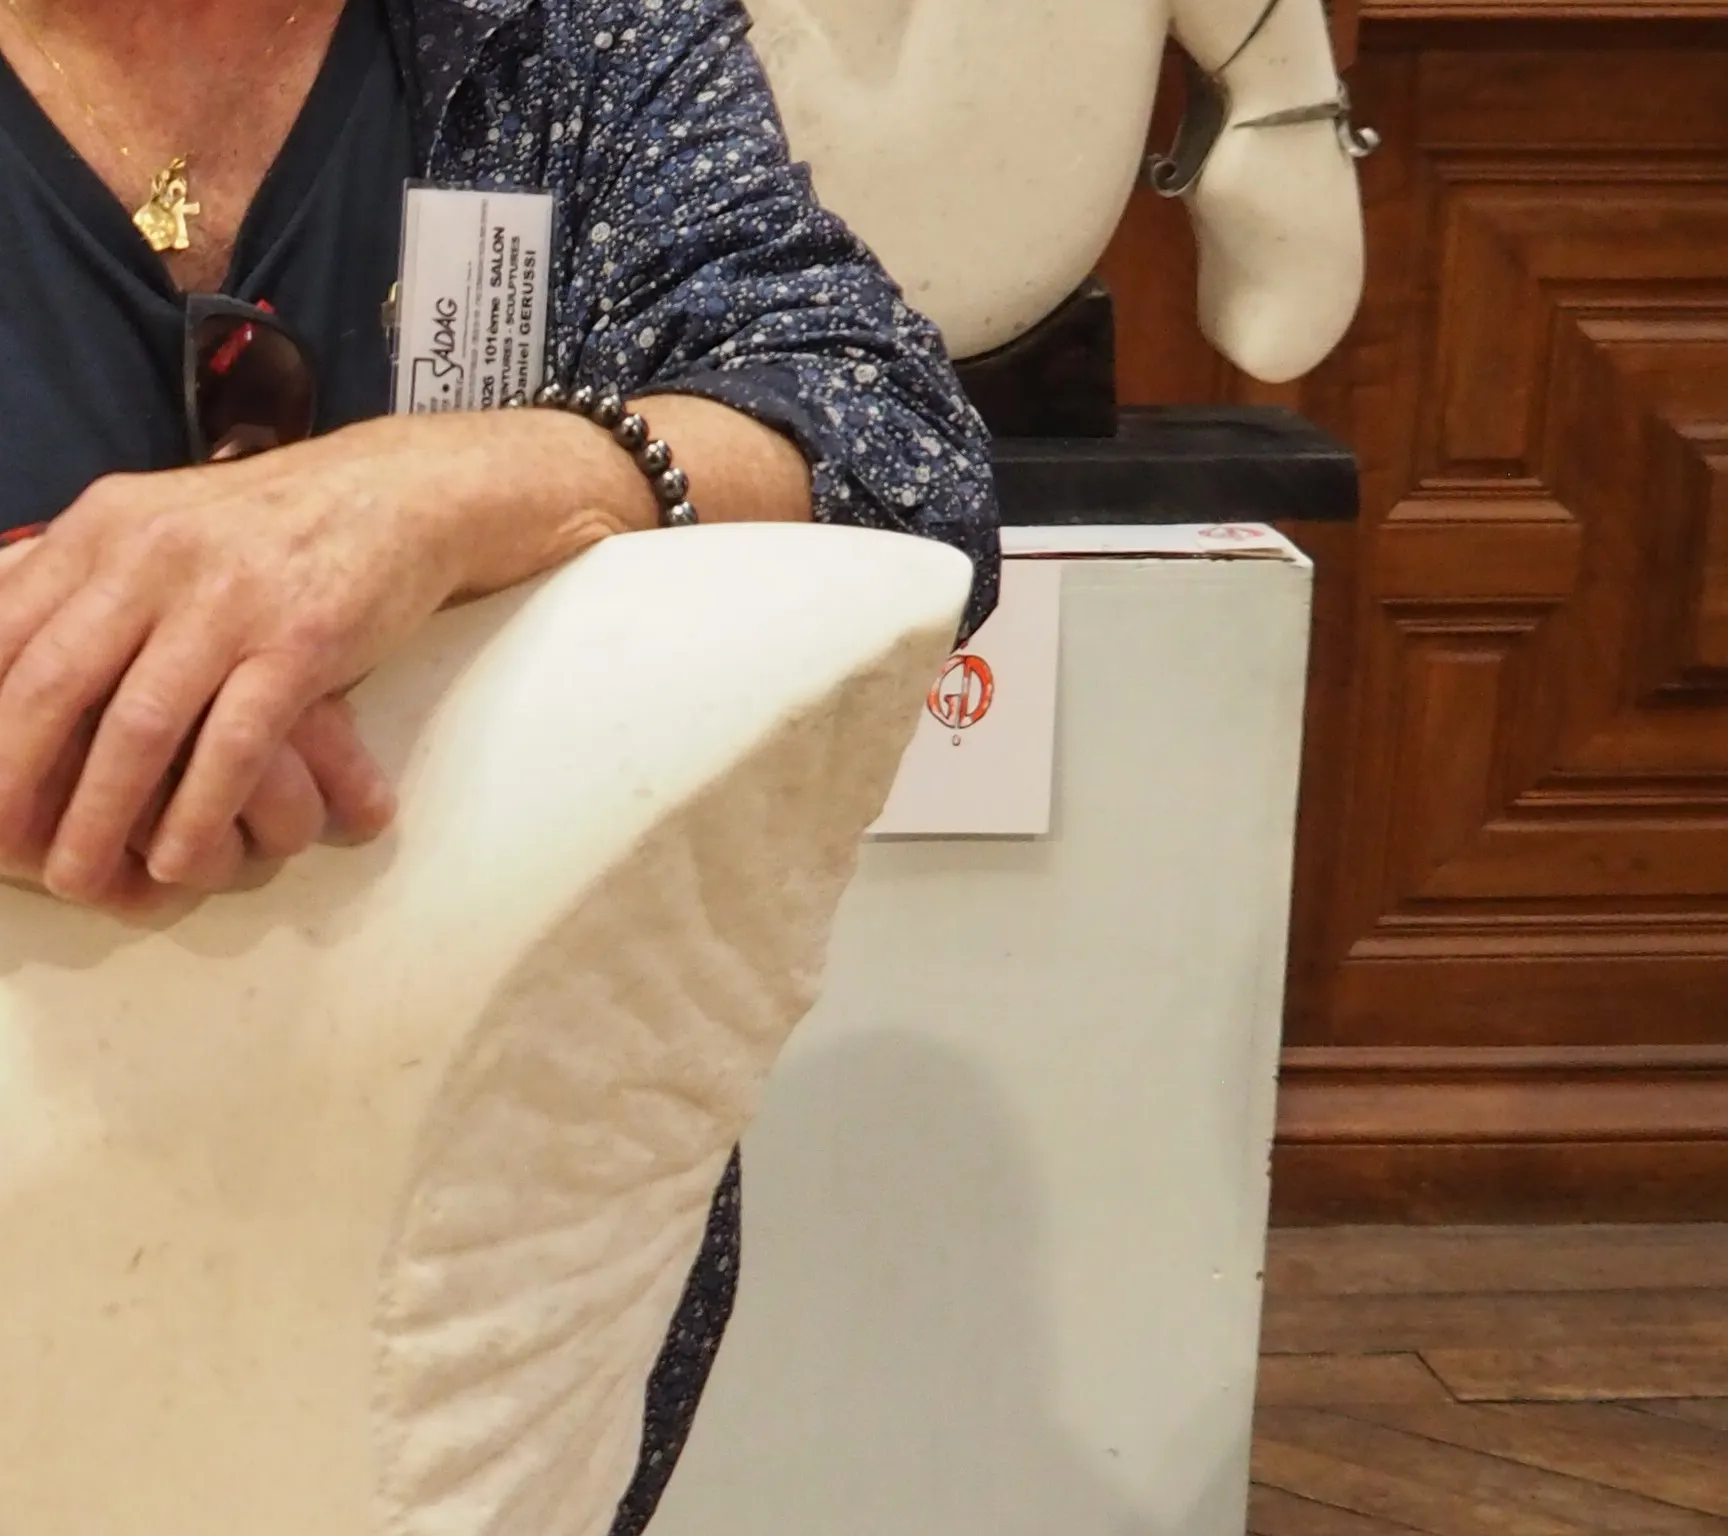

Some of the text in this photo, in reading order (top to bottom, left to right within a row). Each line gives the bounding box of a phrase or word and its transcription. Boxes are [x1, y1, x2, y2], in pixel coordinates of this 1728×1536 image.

[490, 226, 505, 287] SALON
[505, 236, 520, 325] SCULPTURES
[520, 250, 536, 335] GERUSSI
